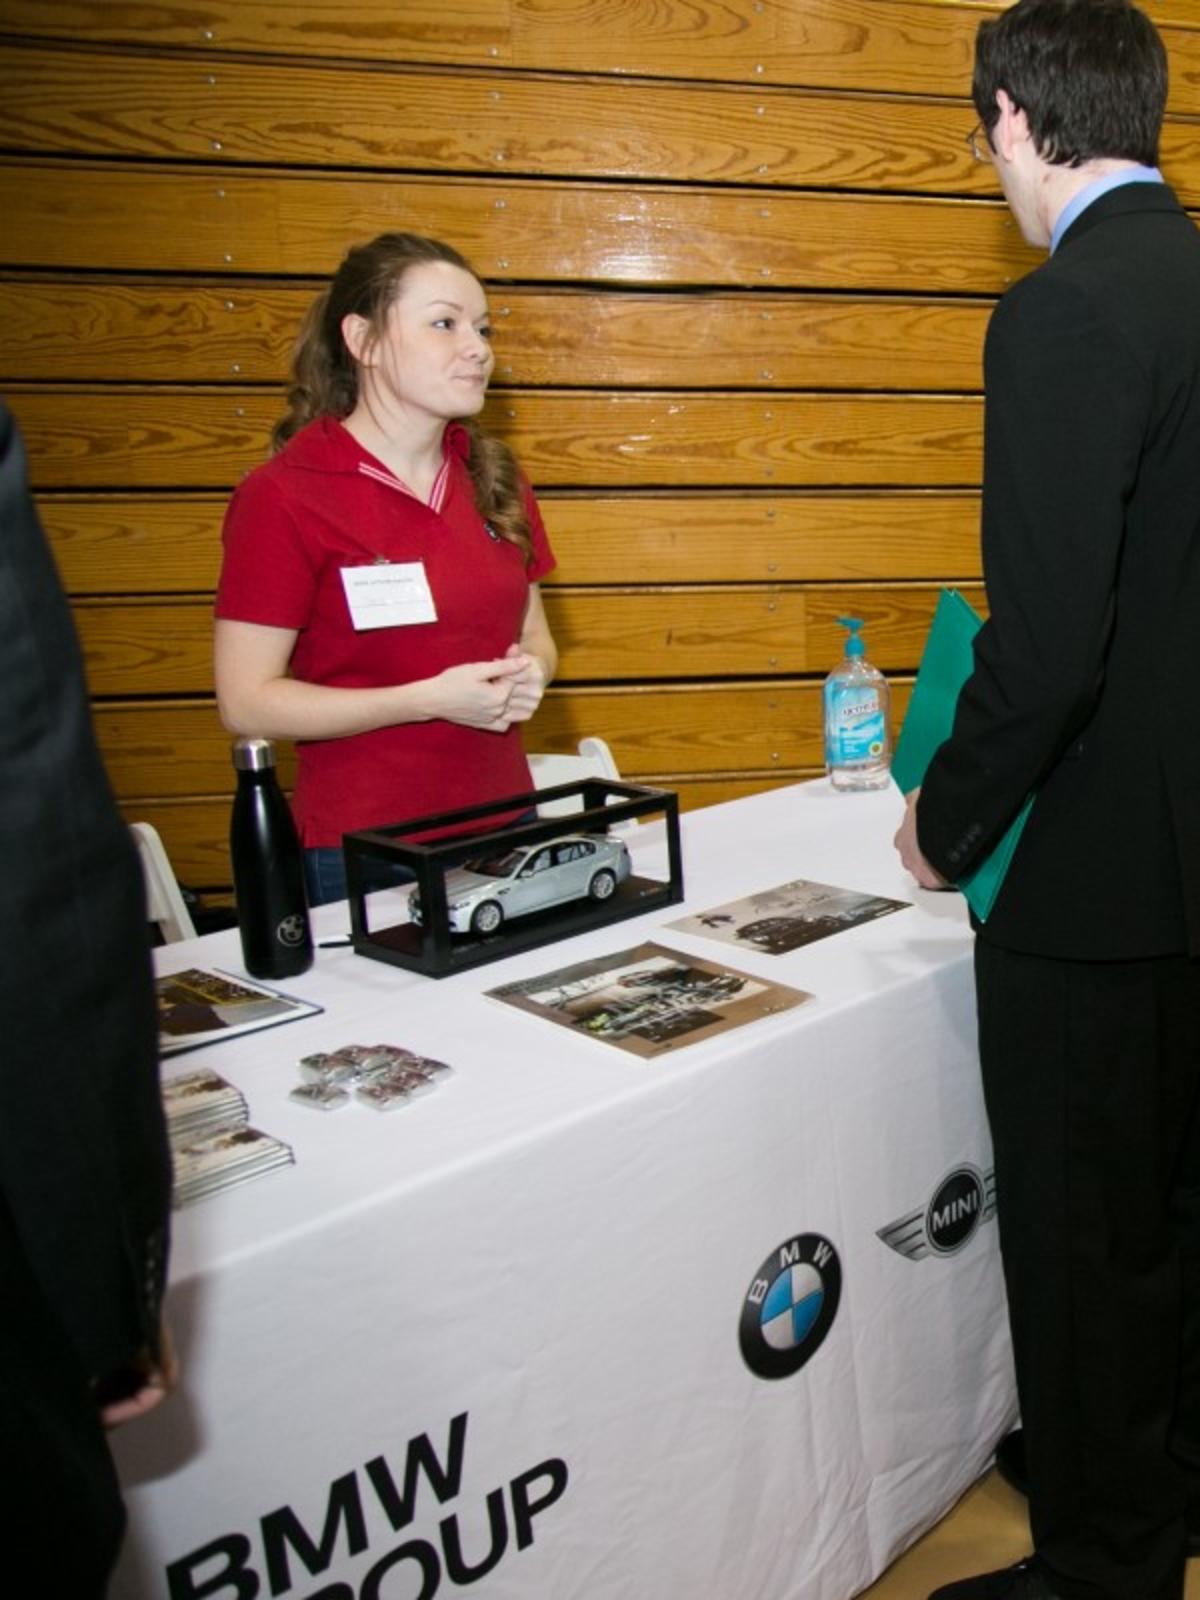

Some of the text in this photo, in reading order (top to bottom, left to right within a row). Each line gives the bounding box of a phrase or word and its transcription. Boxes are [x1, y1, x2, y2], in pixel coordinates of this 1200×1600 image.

[931, 1189, 979, 1234] MINI
[747, 1239, 833, 1305] BMW
[165, 1410, 469, 1600] BMW
[302, 1457, 569, 1600] OUP
